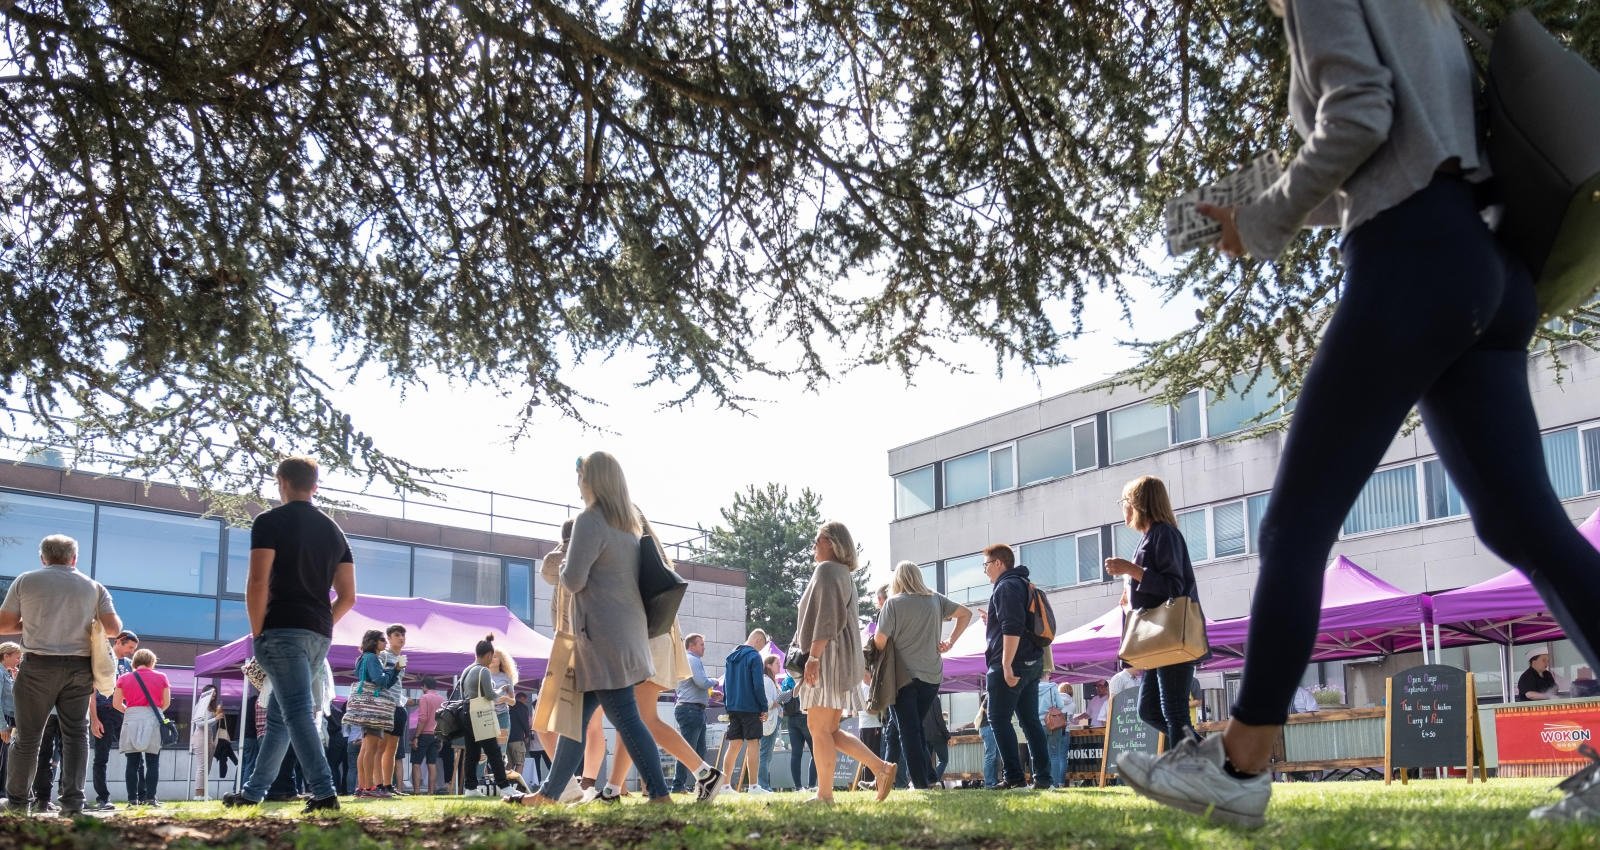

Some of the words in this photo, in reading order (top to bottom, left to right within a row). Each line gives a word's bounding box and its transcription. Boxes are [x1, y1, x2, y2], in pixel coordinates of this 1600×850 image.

[1407, 674, 1421, 686] Open
[1404, 685, 1428, 695] September
[1400, 697, 1412, 711] Thai
[1417, 699, 1430, 711] Green
[1433, 699, 1452, 711] Chicken
[1407, 713, 1423, 728] Curry
[1430, 712, 1444, 724] Rice
[1541, 729, 1591, 742] WOKON
